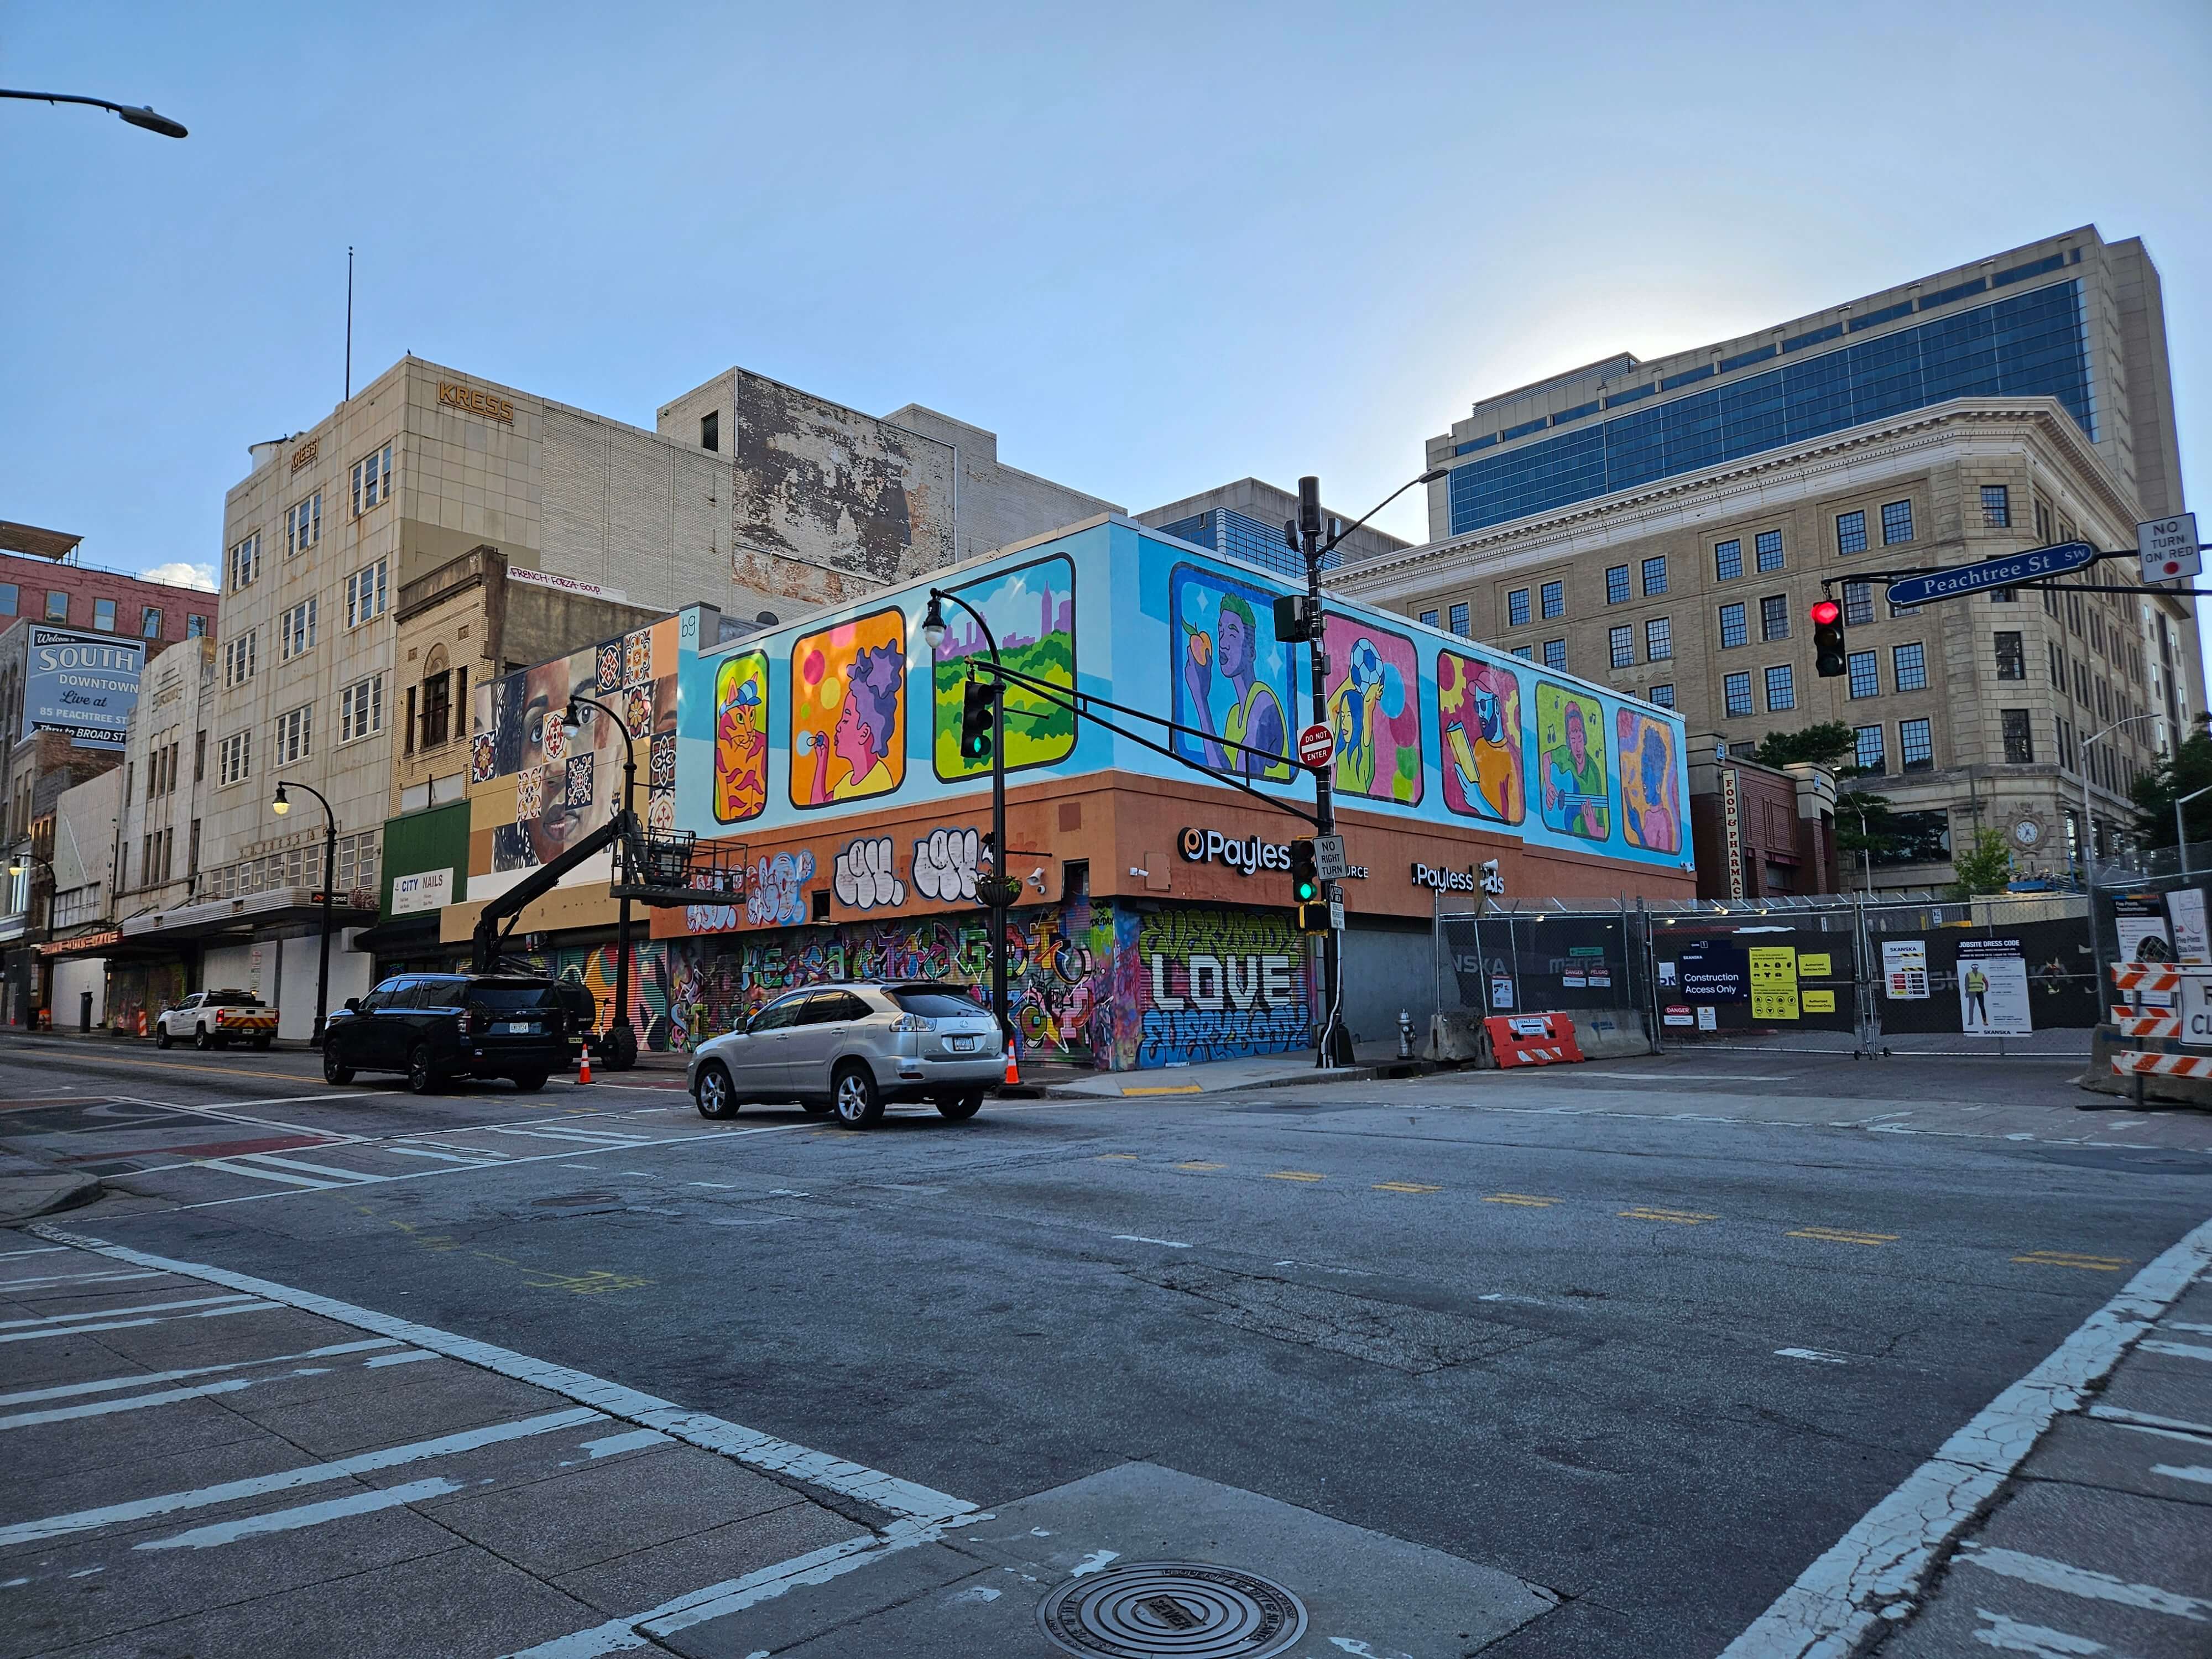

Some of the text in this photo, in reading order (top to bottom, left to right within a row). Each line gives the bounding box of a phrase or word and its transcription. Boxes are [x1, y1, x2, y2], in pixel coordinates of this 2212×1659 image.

[440, 382, 515, 421] KRESS
[290, 437, 318, 469] KRESS
[2153, 521, 2178, 536] NO
[2150, 535, 2185, 549] TURN
[2146, 546, 2194, 563] ON RED
[1923, 549, 2085, 594] Peachtree St SW
[37, 634, 70, 643] Welcome
[38, 647, 134, 671] SOUTH
[59, 674, 139, 693] DOWNTOWN
[59, 690, 107, 707] Live at
[40, 707, 53, 716] 85
[56, 709, 113, 723] PEACHTREE
[76, 729, 111, 740] BROAD
[112, 733, 126, 742] ST
[1316, 731, 1328, 740] NOT
[1307, 750, 1327, 761] ENTER
[1726, 779, 1736, 815] FOOD
[1207, 830, 1291, 875] Payles
[1322, 841, 1335, 852] NO
[1321, 854, 1340, 864] RIGHT
[1322, 865, 1343, 875] TURN
[401, 874, 443, 892] CITY NAILS
[1139, 908, 1301, 968] EVERYBODY
[1151, 954, 1291, 1010] LOVE
[1684, 973, 1739, 982] Construction
[1717, 984, 1736, 995] Only
[1162, 1569, 1232, 1584] PROPERTY
[1149, 1599, 1193, 1630] SEWER
